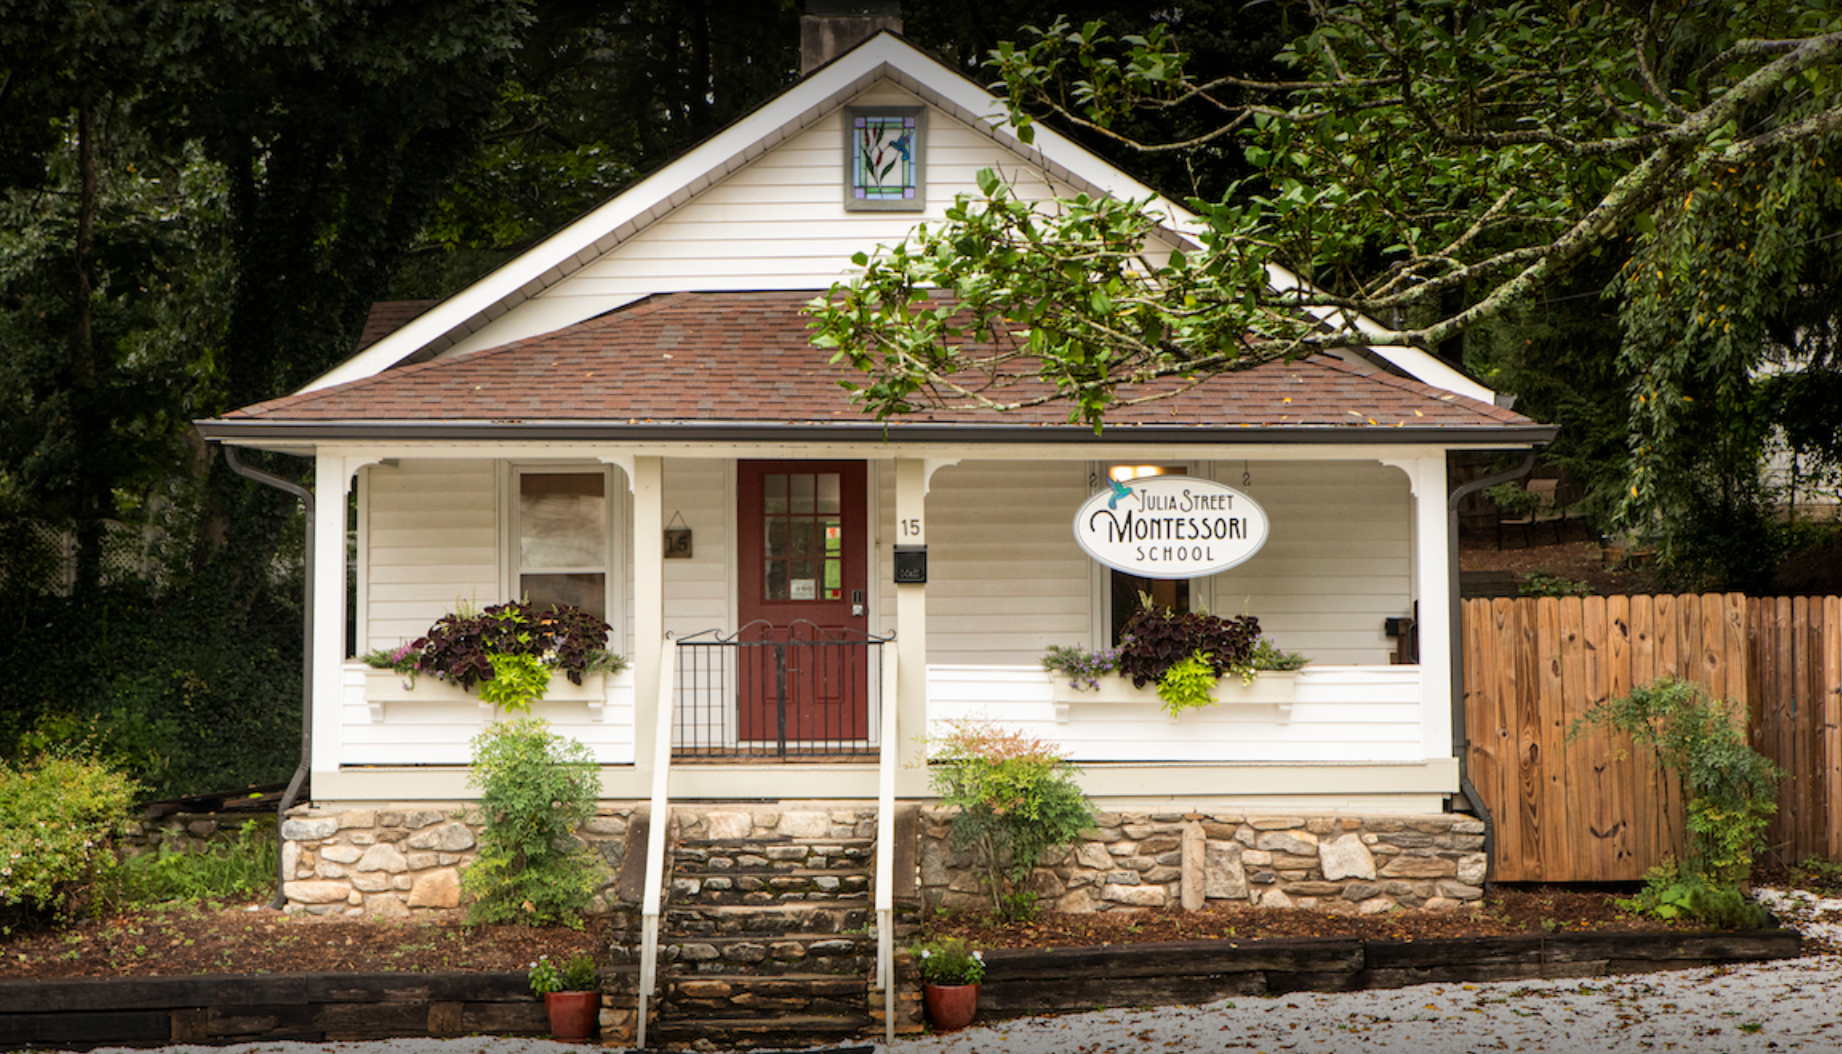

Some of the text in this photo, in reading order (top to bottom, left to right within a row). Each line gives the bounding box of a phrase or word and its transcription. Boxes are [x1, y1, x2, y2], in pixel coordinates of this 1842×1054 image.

[1138, 489, 1234, 512] JULIA STREET
[901, 519, 920, 536] 15
[1090, 509, 1247, 543] MONTESSORI
[667, 535, 688, 553] 15
[1136, 546, 1214, 561] SCHOOL
